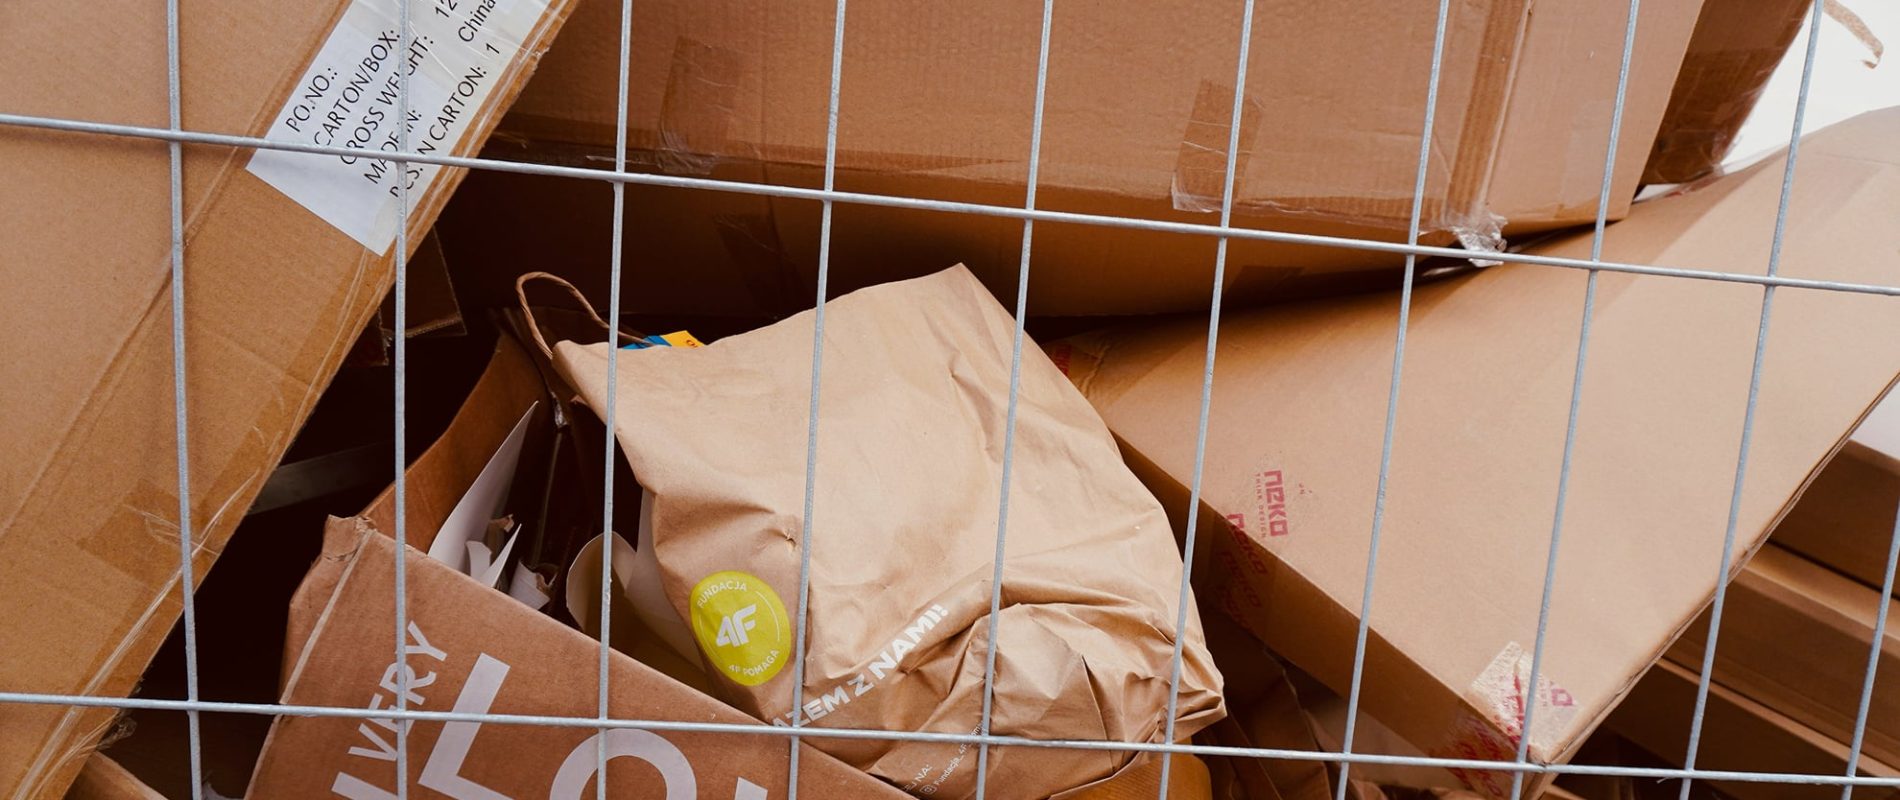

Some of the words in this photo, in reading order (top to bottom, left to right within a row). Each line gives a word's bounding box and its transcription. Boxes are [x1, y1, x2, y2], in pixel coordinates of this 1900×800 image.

[458, 0, 497, 42] China
[313, 29, 401, 146] CARTON/BOX:
[429, 66, 488, 141] CARTON:
[485, 42, 501, 56] 1
[696, 580, 748, 609] FUNDACJA
[715, 603, 757, 648] 4F
[742, 649, 780, 677] POMAGA
[847, 673, 878, 699] Z
[867, 603, 950, 681] NAMI!
[347, 619, 448, 763] VERY
